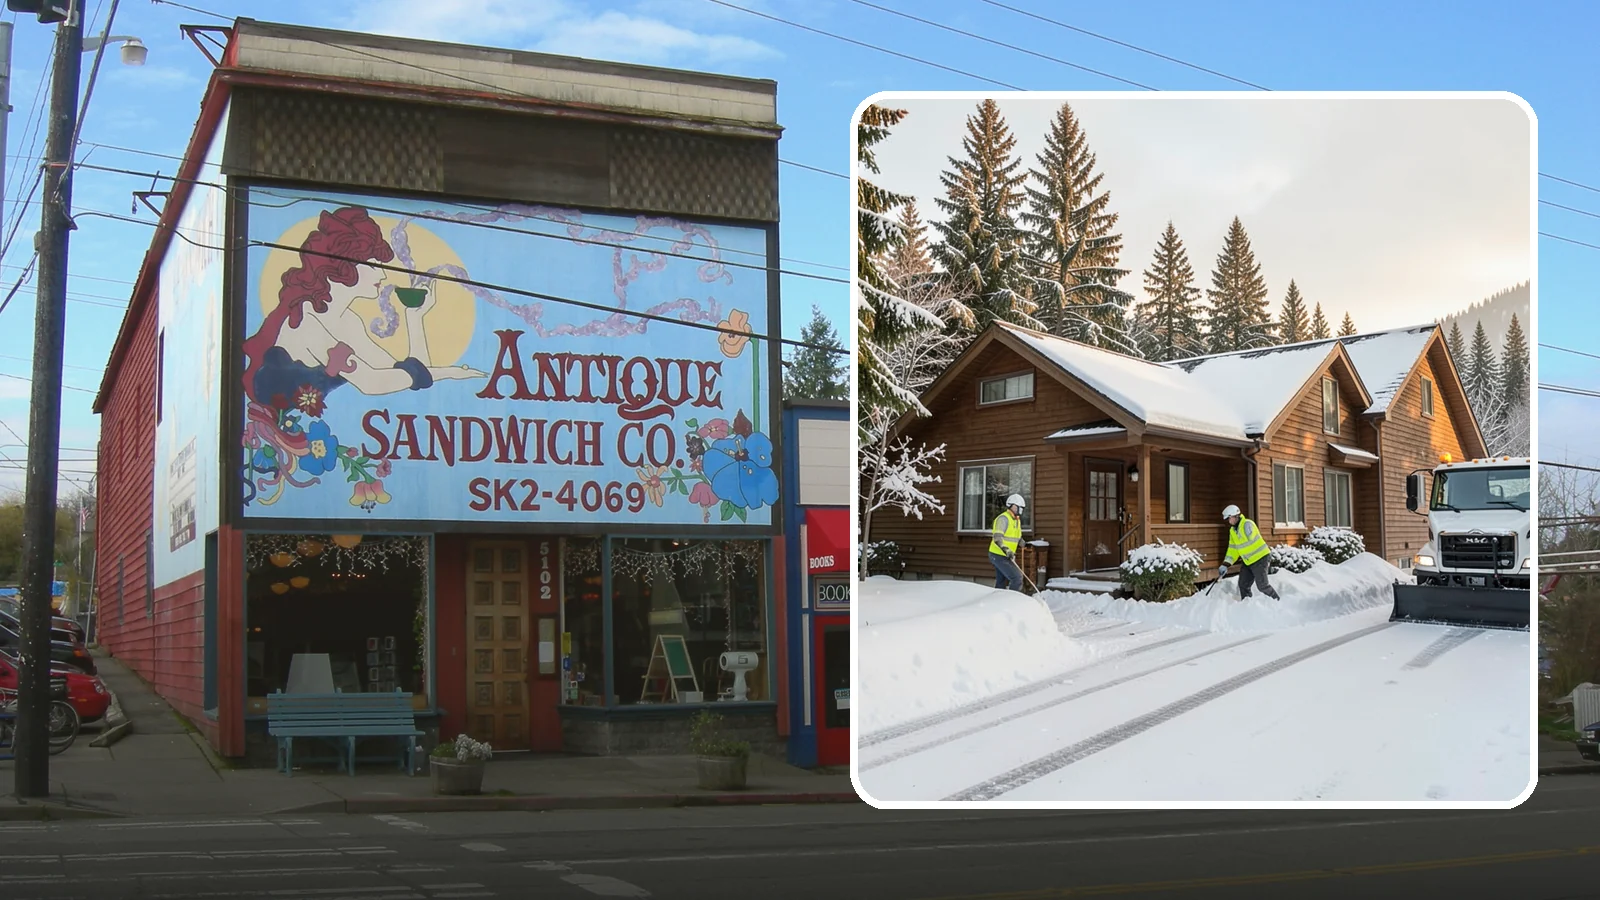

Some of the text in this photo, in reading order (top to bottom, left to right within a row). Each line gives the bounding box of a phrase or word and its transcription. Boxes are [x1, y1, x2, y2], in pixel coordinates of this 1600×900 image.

[476, 329, 723, 420] ANTIQUE
[362, 408, 685, 468] SANDWICH CO.
[468, 477, 646, 513] SK2-4069
[540, 542, 551, 599] 5102
[809, 555, 835, 569] BOOKS
